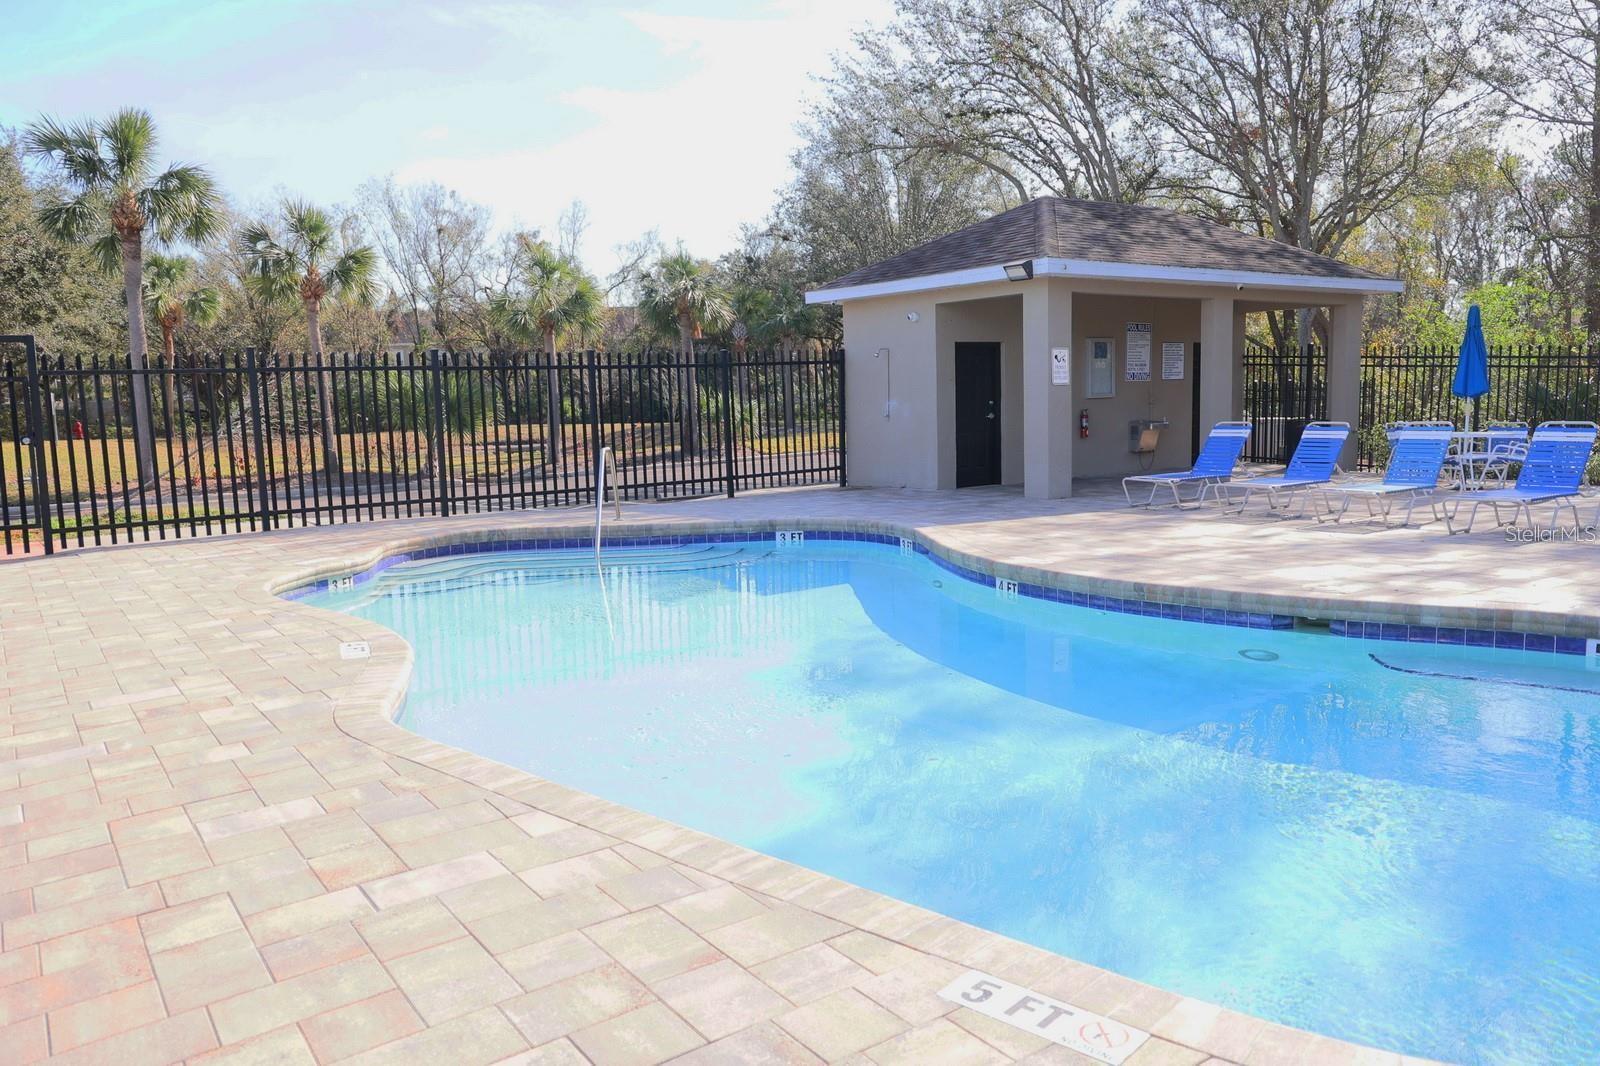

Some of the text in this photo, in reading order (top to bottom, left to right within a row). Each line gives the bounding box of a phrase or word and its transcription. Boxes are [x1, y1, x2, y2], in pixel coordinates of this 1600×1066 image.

[1128, 324, 1138, 332] POOL
[780, 532, 803, 541] 3 FT
[332, 580, 338, 589] 3
[1007, 582, 1017, 593] FT
[961, 980, 1075, 1029] 5 FT
